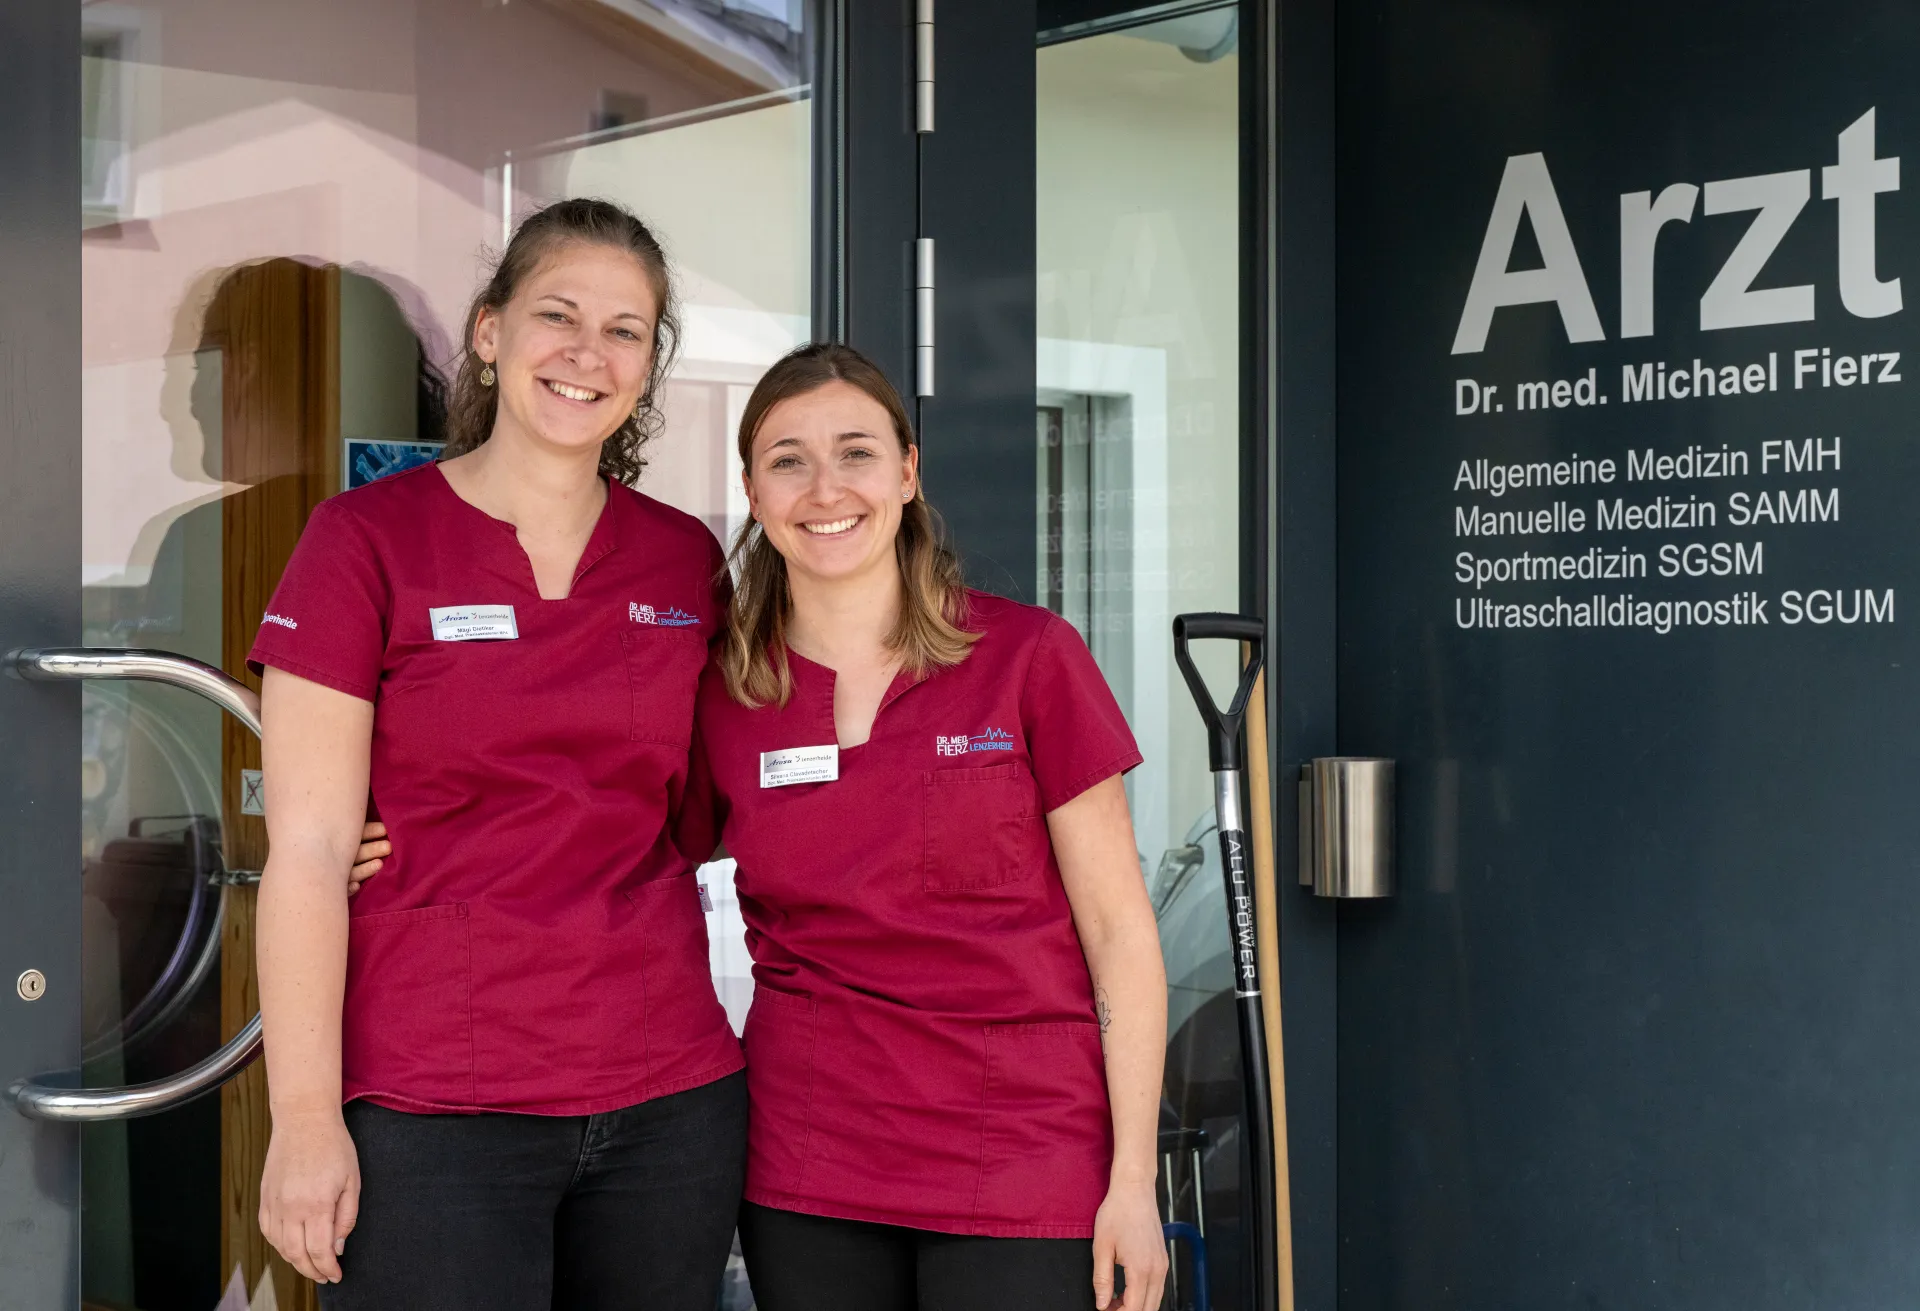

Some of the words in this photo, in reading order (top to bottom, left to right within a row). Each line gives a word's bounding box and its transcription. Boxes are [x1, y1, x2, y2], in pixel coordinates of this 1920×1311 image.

[1451, 106, 1903, 354] Arzt
[1455, 379, 1504, 416] Dr.
[1517, 368, 1608, 411] med.
[1622, 352, 1778, 403] Michael
[1794, 348, 1902, 390] Fierz
[1453, 452, 1617, 498] Allgemeine
[1627, 443, 1750, 483] Medizin
[1761, 437, 1842, 475] FMH
[1455, 500, 1587, 537] Manuelle
[1597, 494, 1717, 532] Medizin
[1728, 488, 1840, 526] SAMM
[1455, 546, 1648, 590] Sportmedizin
[1658, 541, 1764, 578] SGSM
[629, 610, 658, 625] FIERZ
[1456, 592, 1770, 635] Ultraschalldiagnostik
[1779, 588, 1896, 626] SGUM
[936, 735, 949, 744] DR.
[936, 742, 969, 756] FIERZ
[969, 741, 1014, 752] LENZERHEIDE
[1228, 839, 1245, 884] ALU
[1234, 896, 1256, 980] POWER
